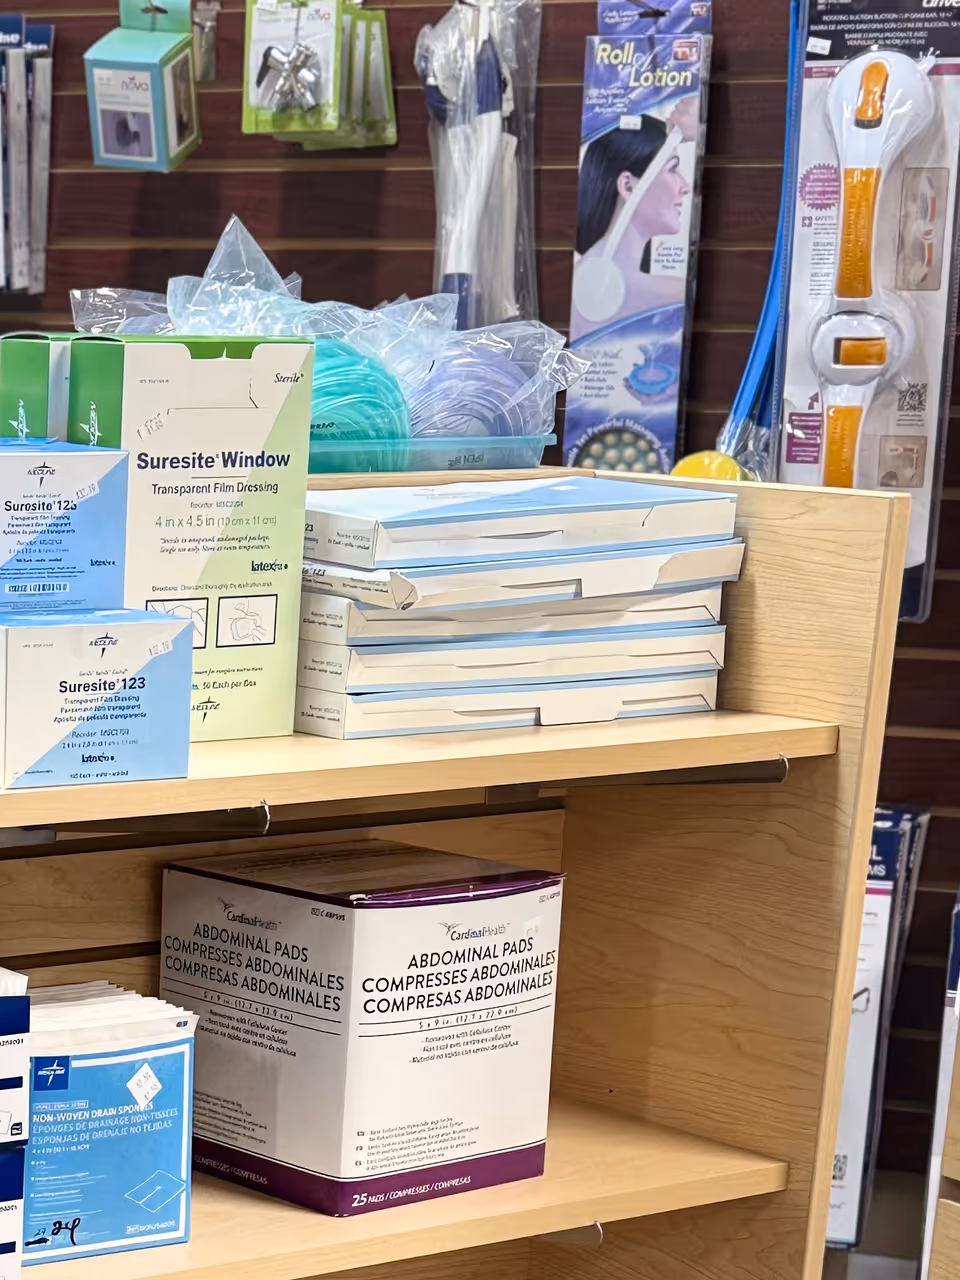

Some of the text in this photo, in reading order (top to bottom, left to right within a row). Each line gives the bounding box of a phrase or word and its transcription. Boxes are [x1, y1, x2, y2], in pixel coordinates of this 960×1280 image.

[596, 42, 634, 64] Roll
[121, 80, 149, 92] nova
[629, 66, 691, 87] Lotion
[136, 451, 290, 470] Suresite Window
[152, 481, 278, 496] Transparent Film Dressing
[165, 516, 174, 527] in
[186, 515, 203, 527] 4.5
[206, 514, 214, 526] in
[122, 677, 146, 690] 123
[194, 923, 309, 962] ABDOMINAL PADS
[408, 937, 533, 969] ABDOMINAL PADS
[164, 935, 345, 991] COMPRESSES ABDOMINALES
[362, 950, 556, 993] COMPRESSES ABDOMINALES
[165, 956, 341, 1012] COMPRESAS ABDOMINALES
[363, 970, 553, 1013] COMPRESAS ABDOMINALES
[33, 1108, 117, 1122] NON-WOVEN DRAIN
[75, 1122, 86, 1131] DE
[32, 1133, 78, 1144] ESPONJAS
[80, 1131, 90, 1141] DE
[352, 1193, 368, 1207] 25
[390, 1184, 430, 1200] COMPRESSES
[434, 1176, 471, 1191] COMPRESAS
